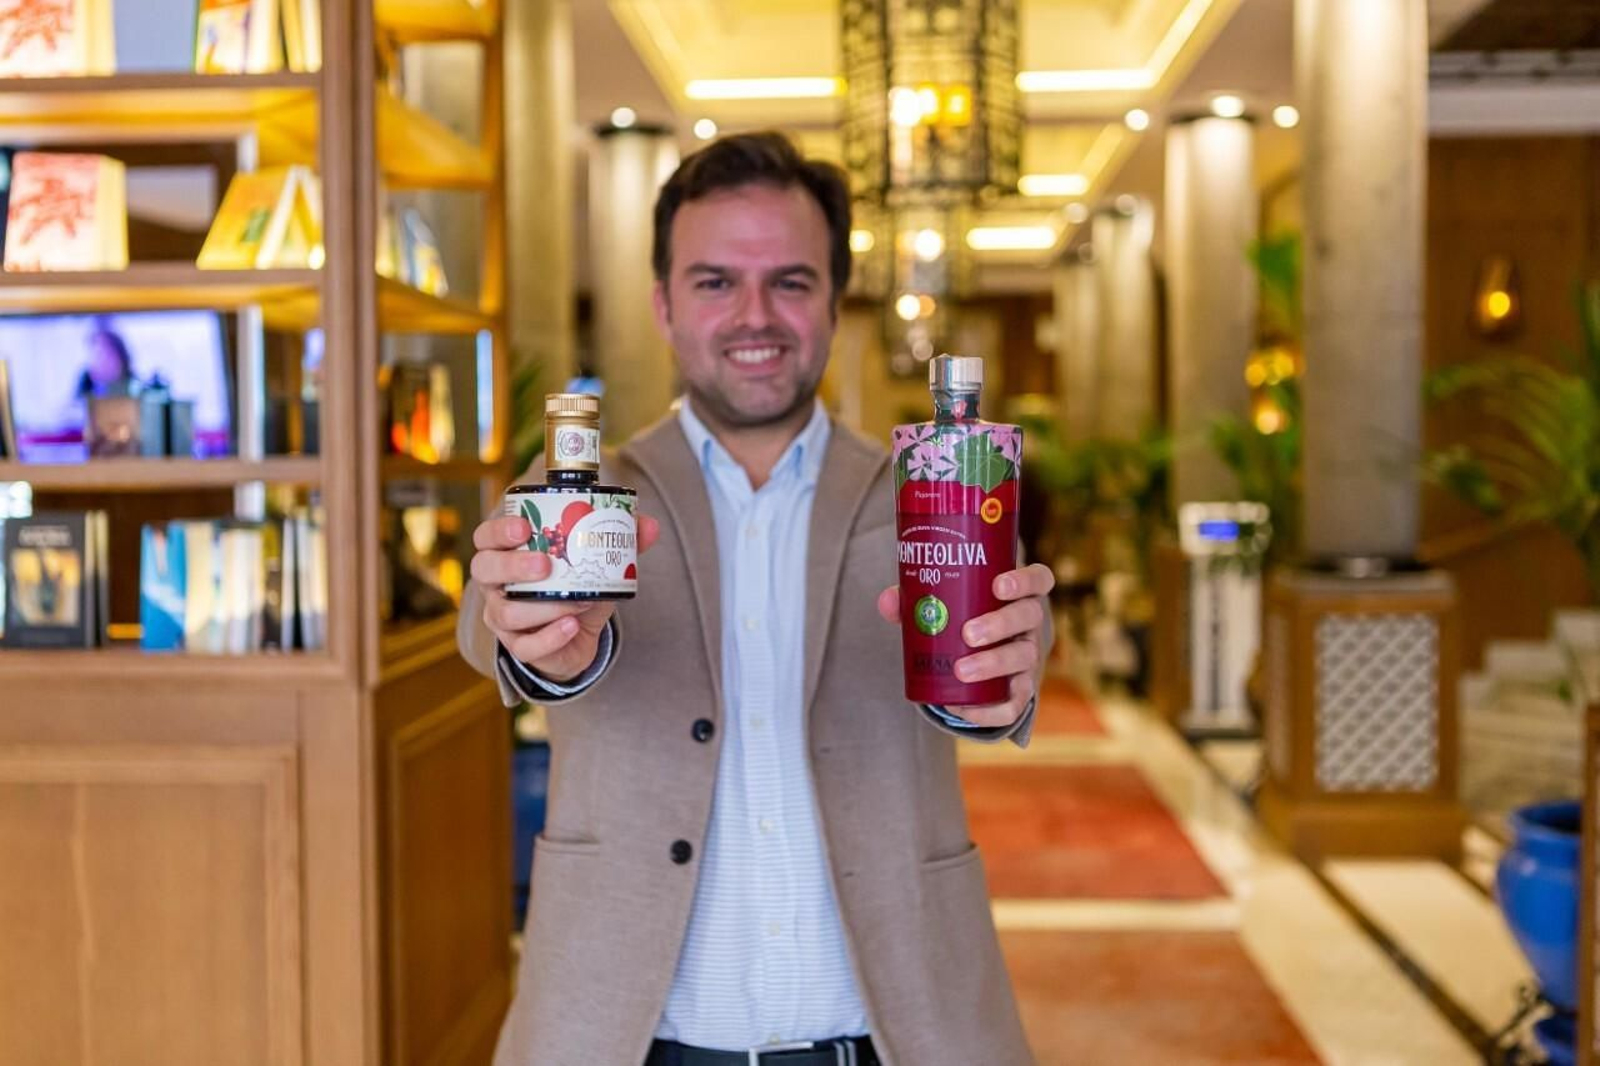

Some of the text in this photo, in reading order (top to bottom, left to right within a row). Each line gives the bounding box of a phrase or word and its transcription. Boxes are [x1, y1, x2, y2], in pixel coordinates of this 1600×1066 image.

[605, 550, 622, 568] ORO
[899, 541, 988, 566] ONTEOLIVA
[919, 567, 941, 586] ORO
